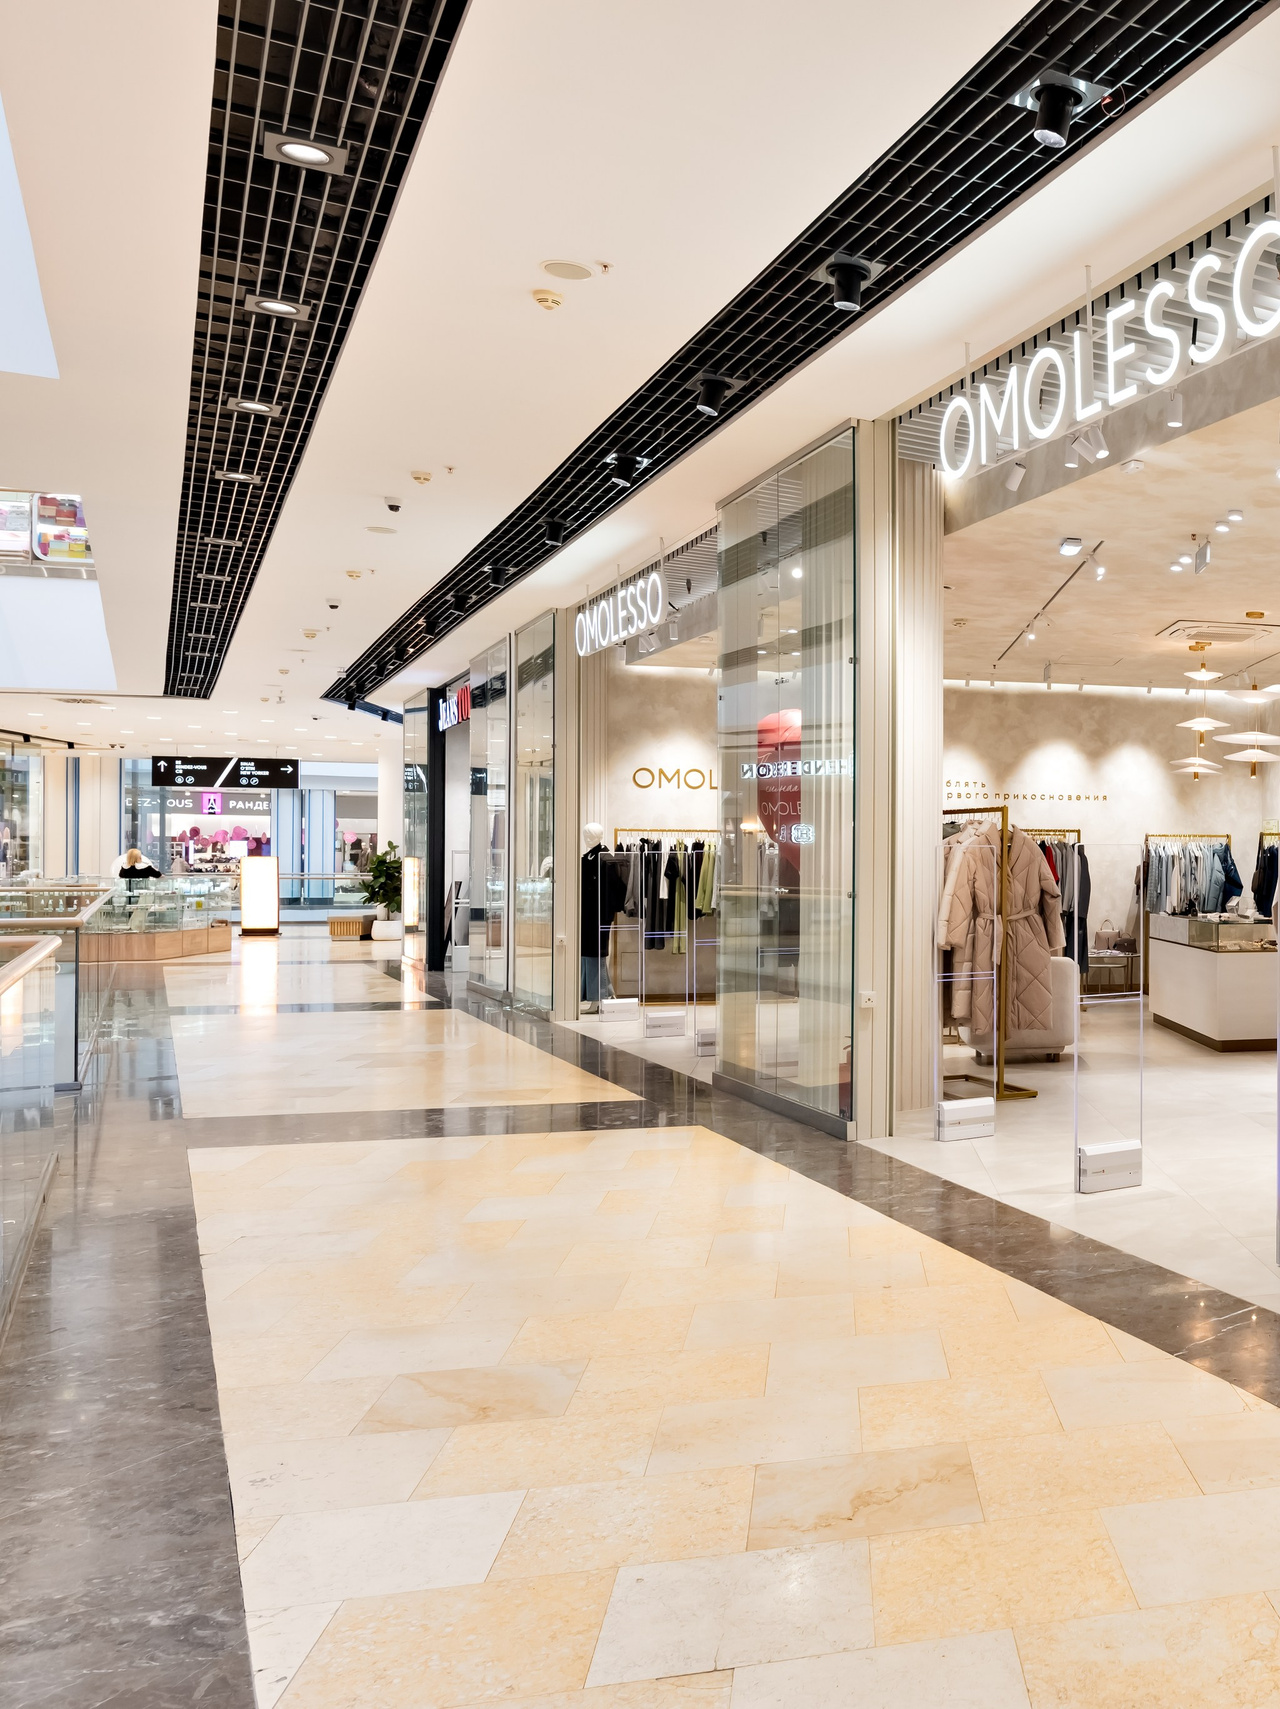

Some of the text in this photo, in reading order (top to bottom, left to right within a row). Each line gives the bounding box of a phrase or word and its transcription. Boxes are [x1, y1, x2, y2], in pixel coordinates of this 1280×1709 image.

[575, 572, 662, 656] OMOLESSO
[632, 767, 718, 790] OMOL
[945, 780, 987, 788] блять
[946, 792, 1108, 801] рвого прикосновения
